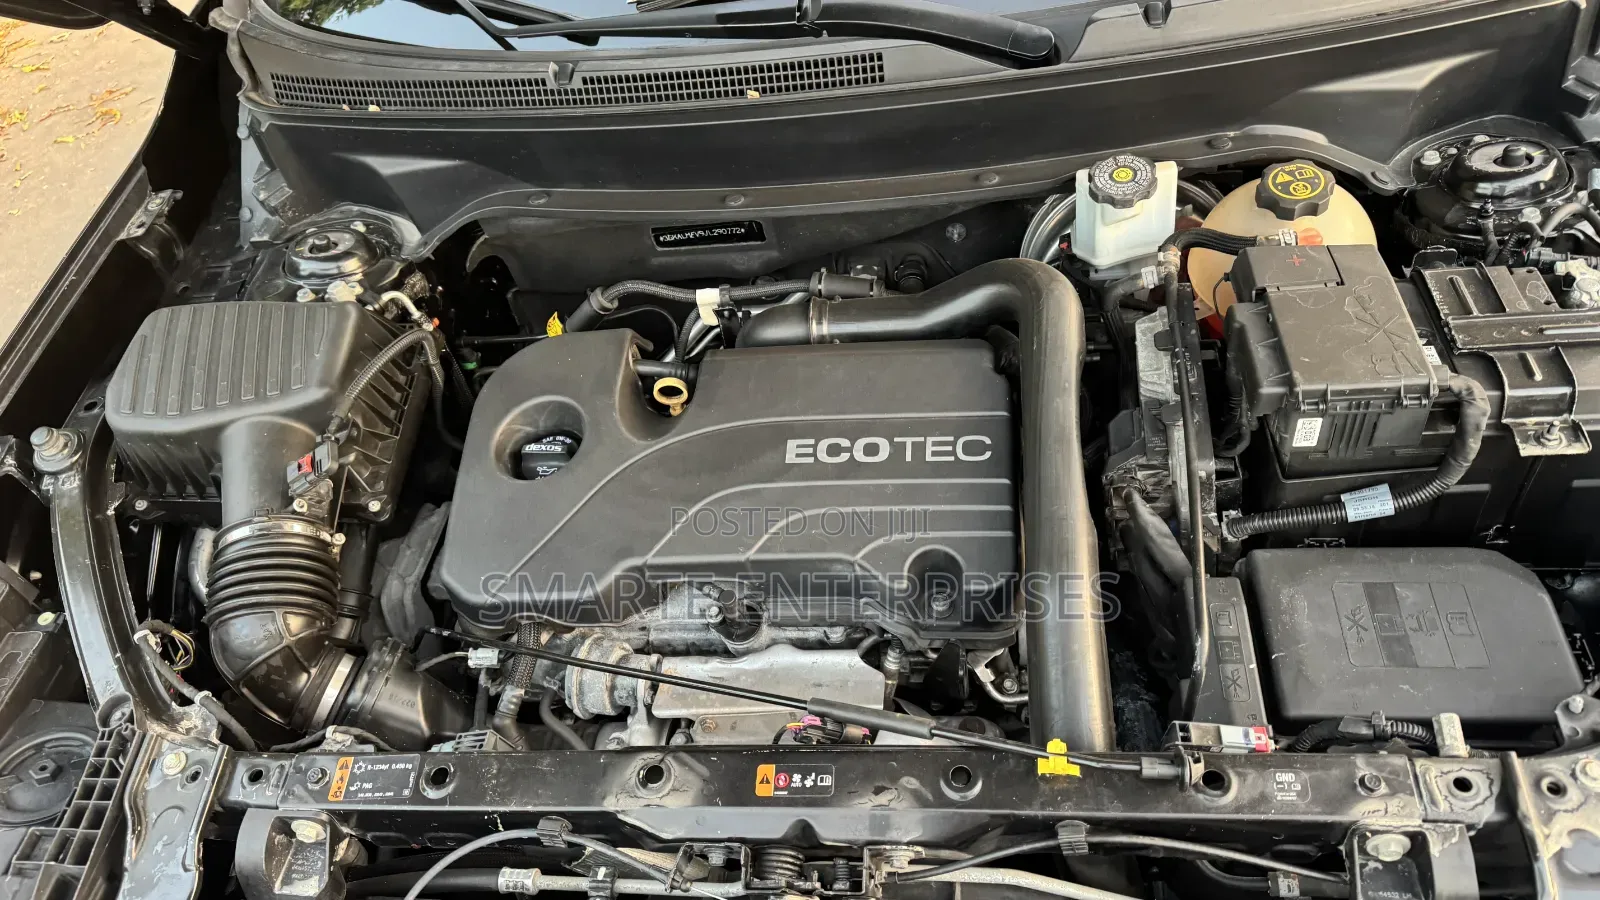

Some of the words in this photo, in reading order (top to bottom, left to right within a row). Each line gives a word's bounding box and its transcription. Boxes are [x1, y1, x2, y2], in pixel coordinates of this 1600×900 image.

[525, 443, 563, 452] dexos
[785, 435, 992, 464] ECOTEC
[1275, 772, 1296, 783] GND
[362, 782, 373, 790] PAG
